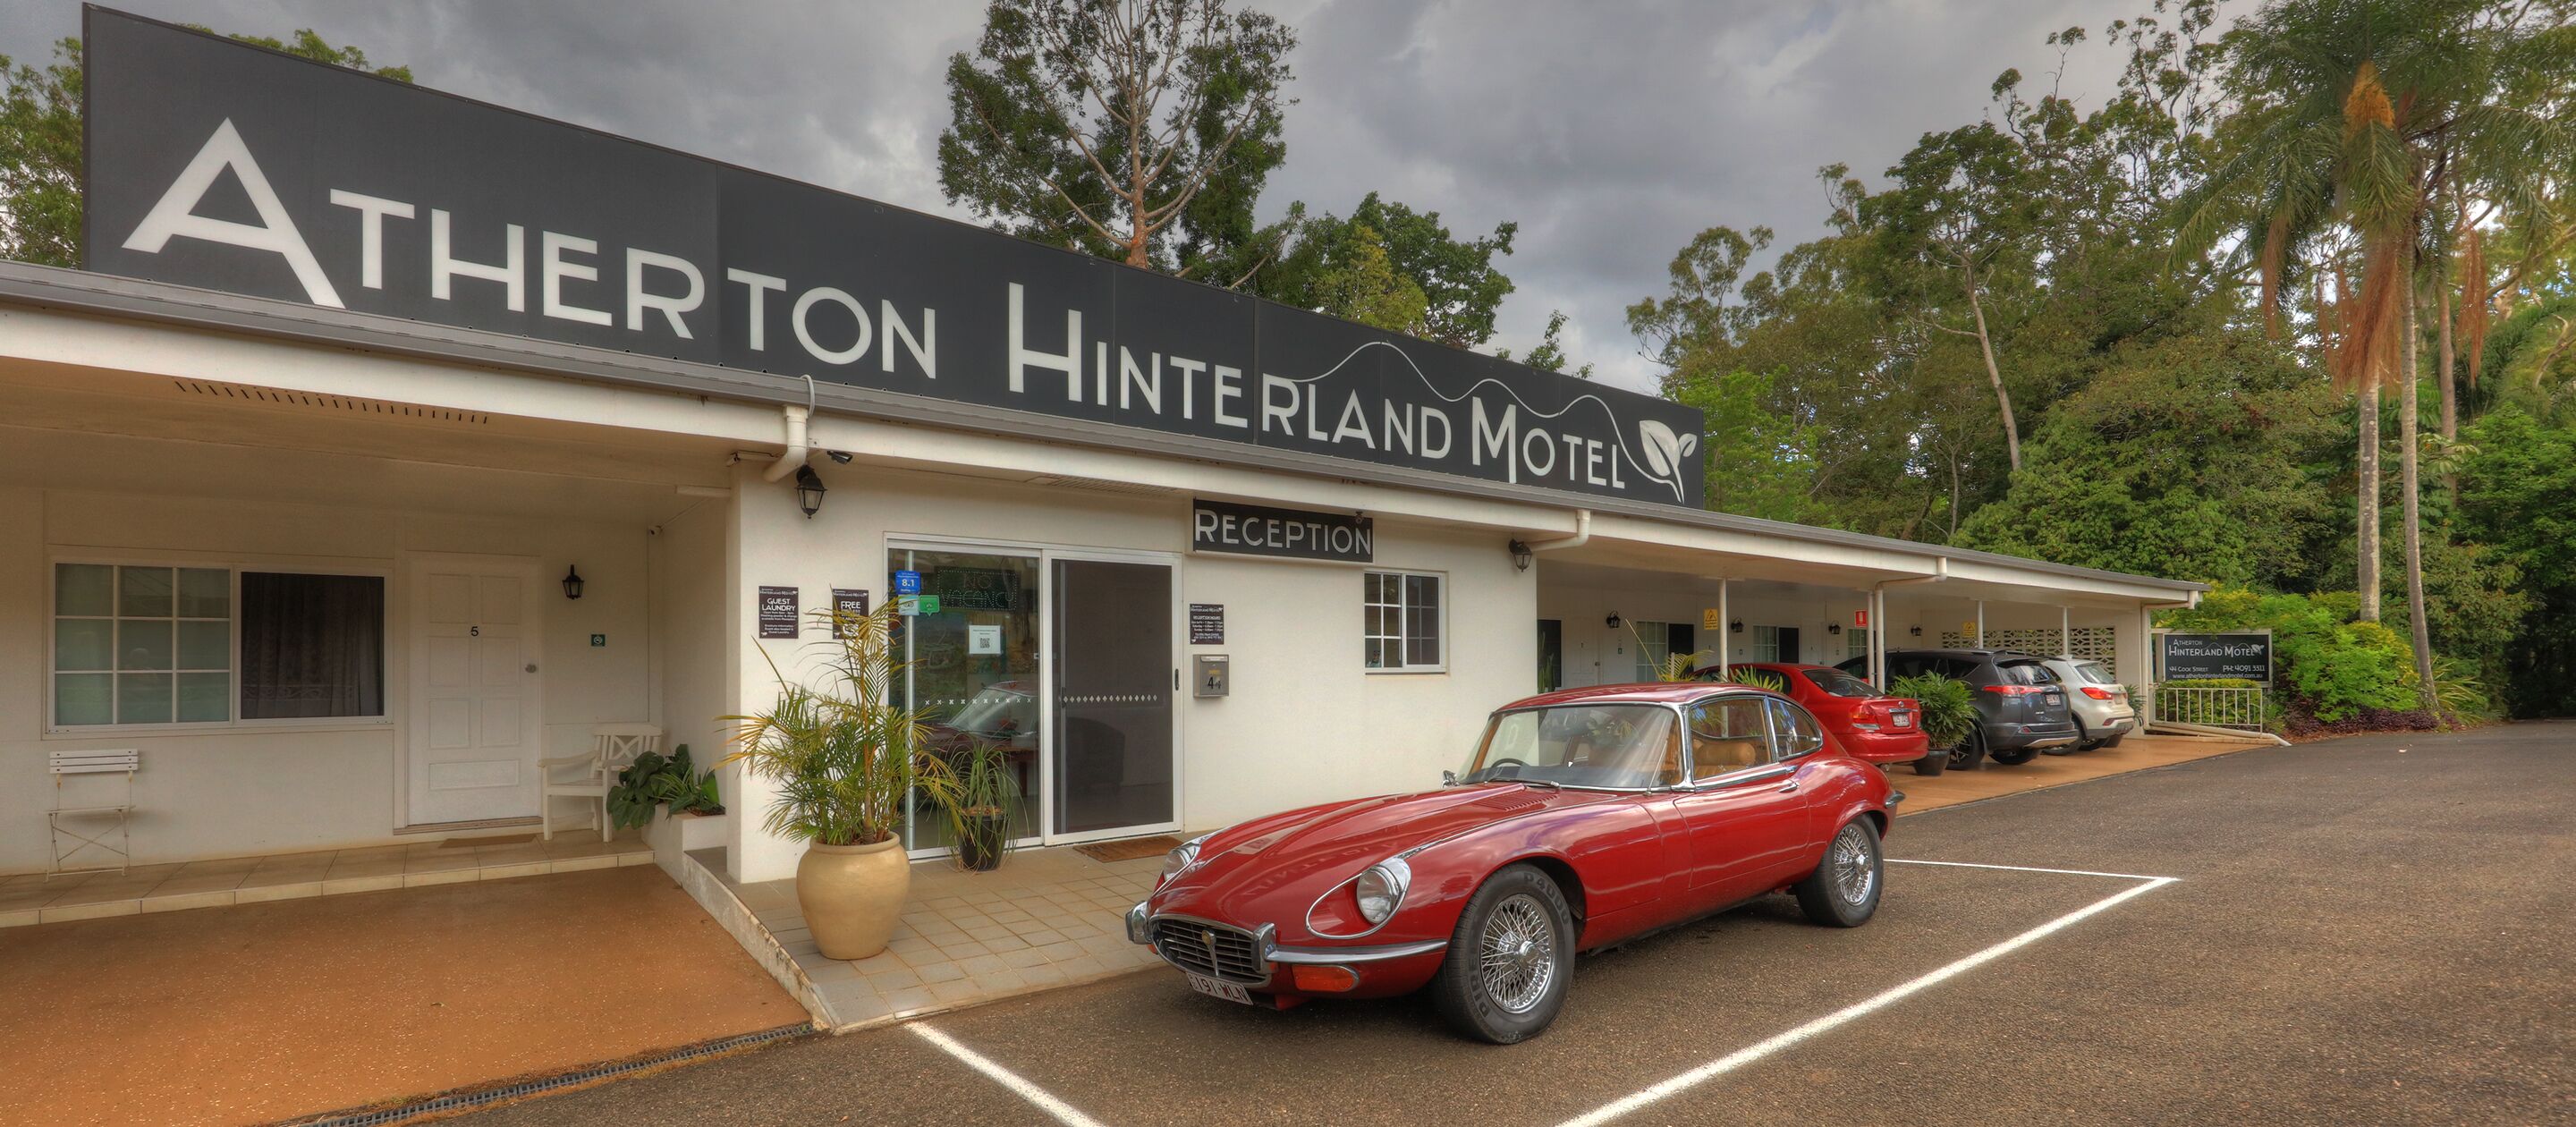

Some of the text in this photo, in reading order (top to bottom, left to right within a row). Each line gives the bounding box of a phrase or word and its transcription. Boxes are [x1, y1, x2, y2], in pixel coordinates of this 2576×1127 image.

[122, 117, 1625, 489] ATHERTON HINTERLAND MOTEL
[1195, 509, 1371, 555] RECEPTION
[902, 579, 915, 587] 8.1
[841, 601, 861, 610] FREE
[470, 626, 479, 637] 5
[2169, 645, 2255, 658] HINTERLAND MOTEL
